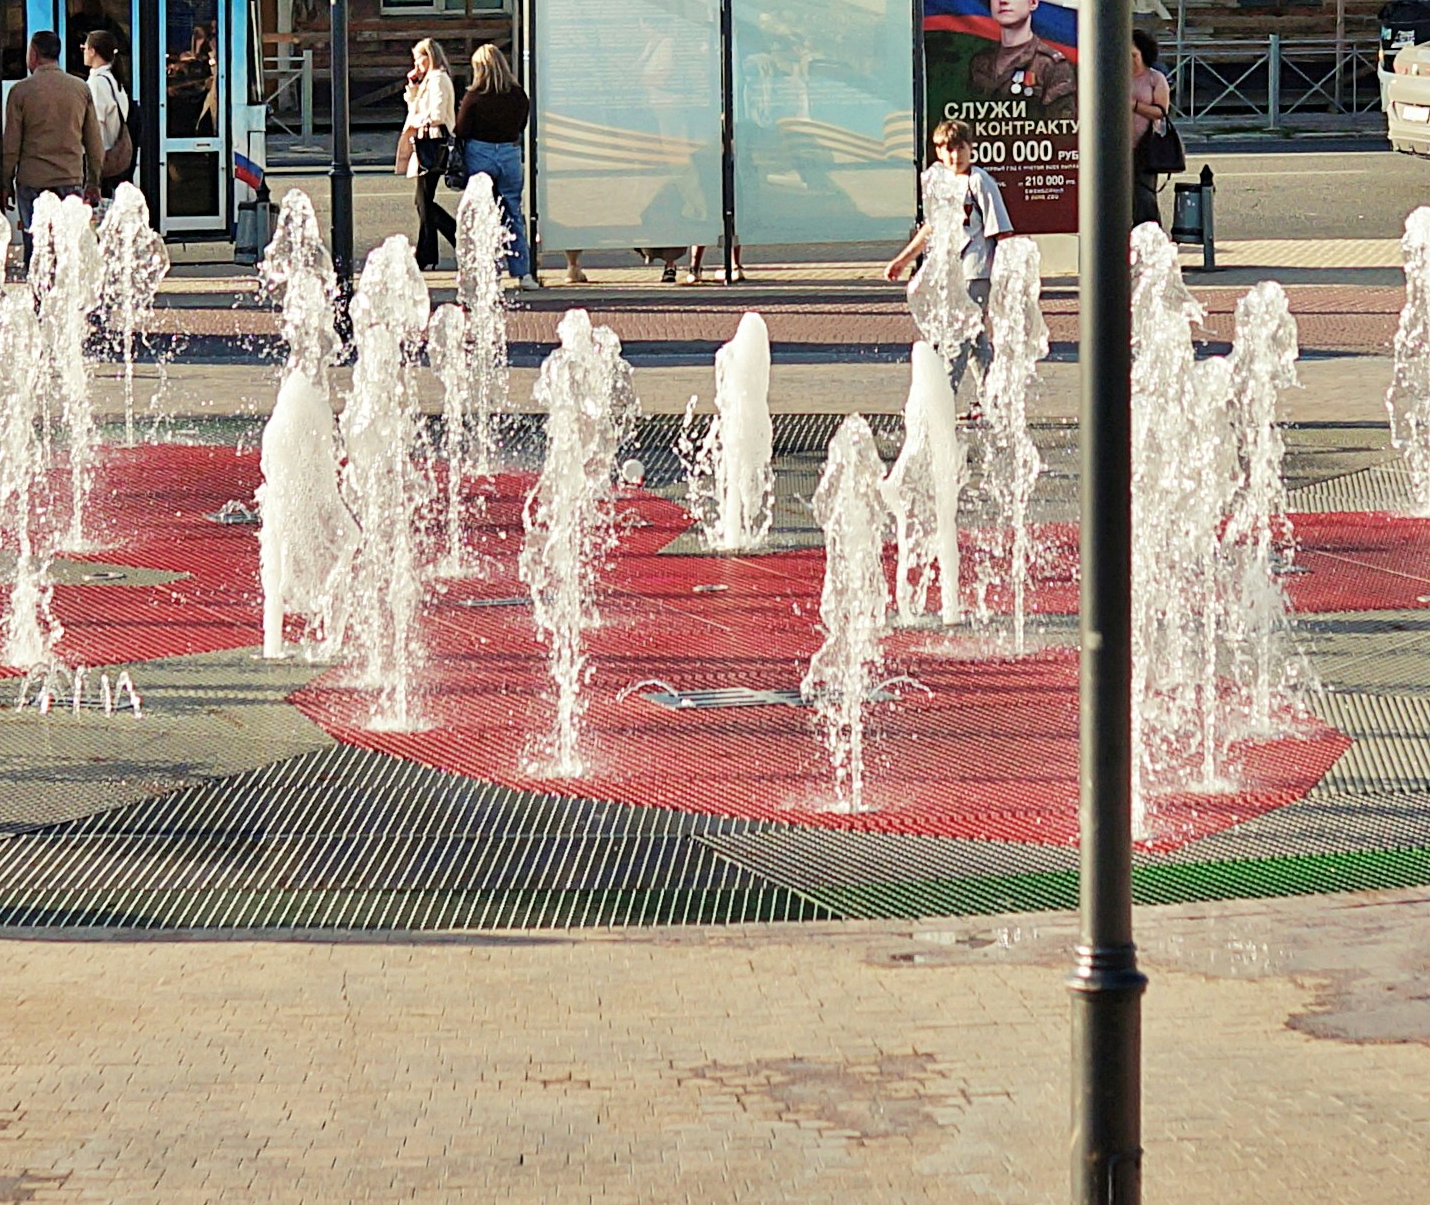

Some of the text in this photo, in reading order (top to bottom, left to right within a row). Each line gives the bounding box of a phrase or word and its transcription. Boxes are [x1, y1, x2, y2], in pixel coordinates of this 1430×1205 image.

[944, 101, 1027, 120] СЛУЖИ
[975, 120, 1079, 136] КОНТРАКТУ
[1012, 140, 1052, 162] 000
[1025, 175, 1044, 186] 210
[1045, 175, 1064, 186] 000
